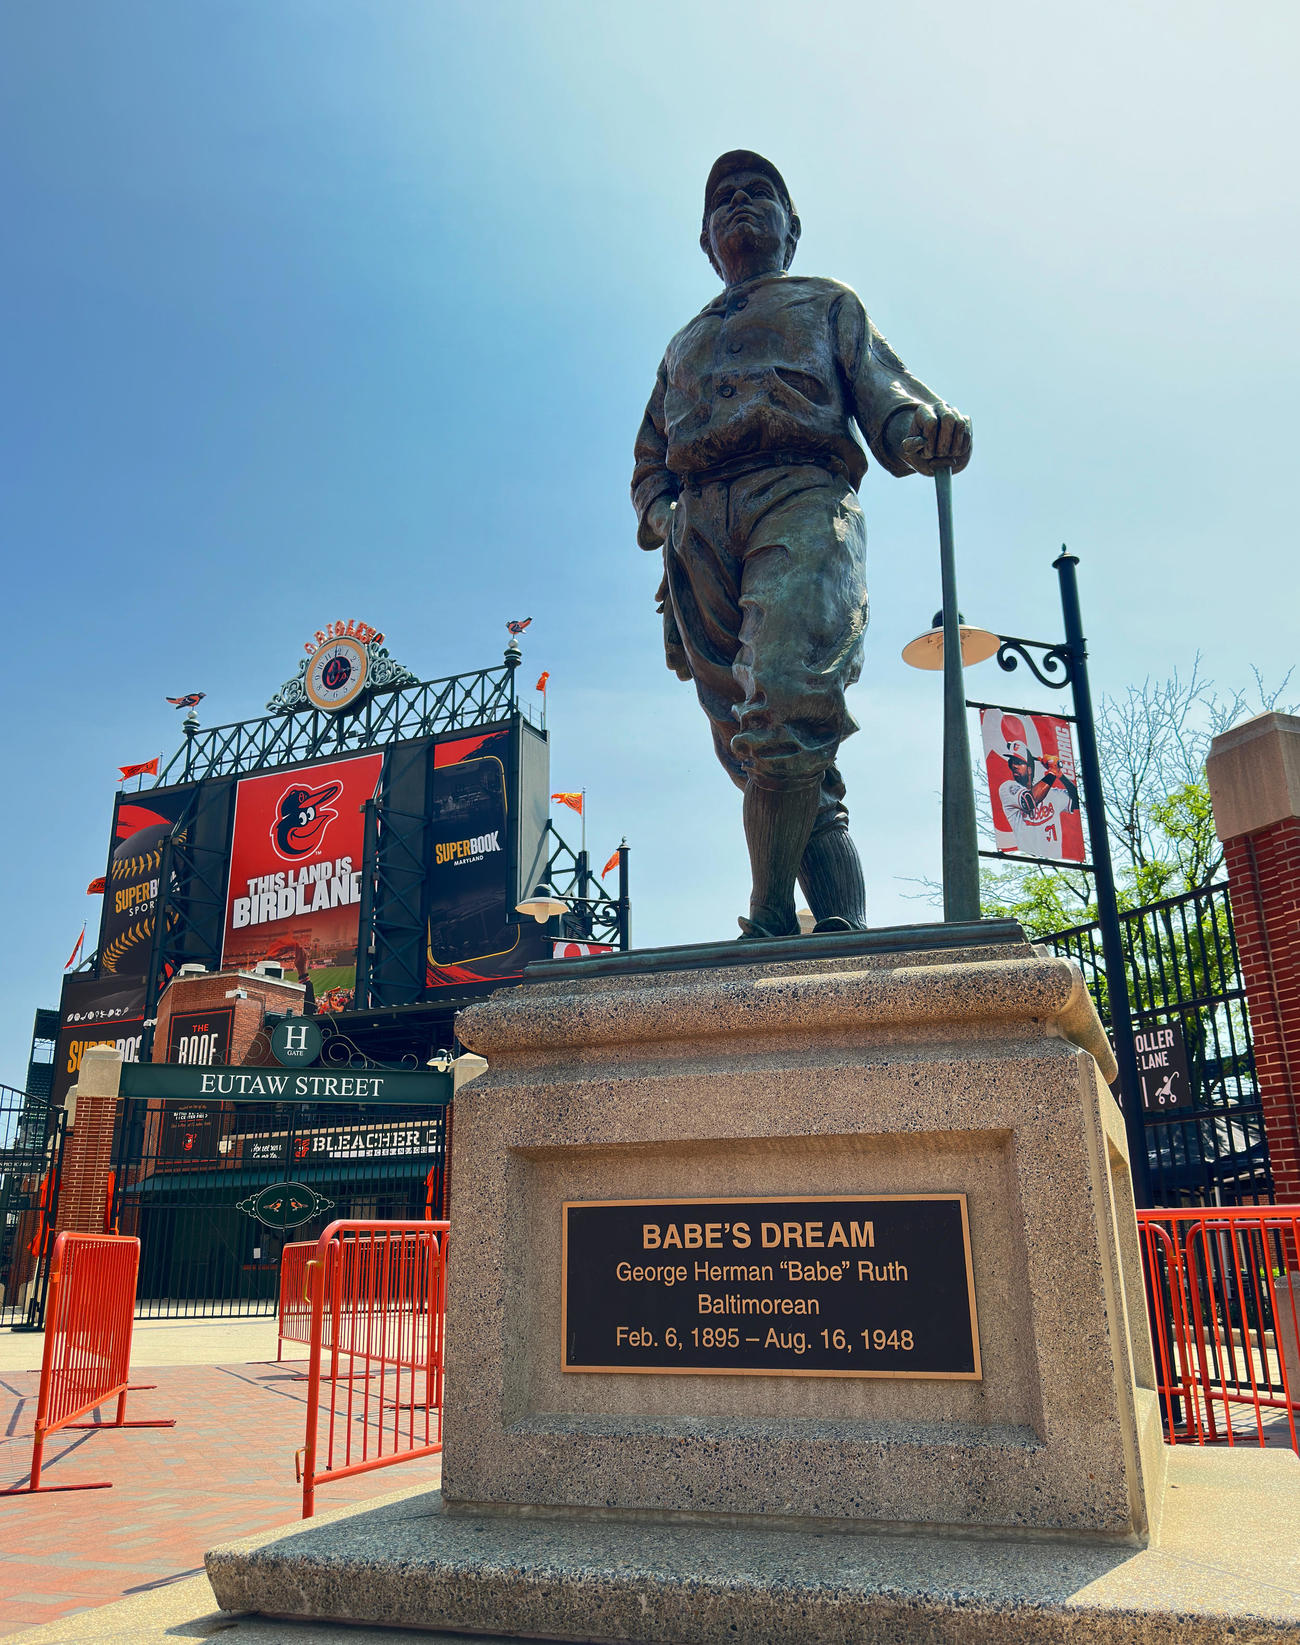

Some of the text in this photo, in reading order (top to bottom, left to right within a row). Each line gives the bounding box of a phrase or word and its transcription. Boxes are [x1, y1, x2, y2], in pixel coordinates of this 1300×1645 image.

[1055, 726, 1075, 780] CEDRIC
[435, 830, 500, 864] SUPERBOOK
[454, 855, 484, 866] MARYLAND
[247, 856, 352, 897] THIS LAND IS
[192, 1024, 209, 1032] THE
[284, 1025, 309, 1050] H
[179, 1034, 218, 1065] ROOF
[1141, 1051, 1169, 1070] LANE
[200, 1074, 384, 1097] EUTAW STREET
[313, 1131, 420, 1151] BLEACHER
[643, 1221, 875, 1248] BABE’S DREAM
[616, 1261, 908, 1287] George Herman “Babe” Ruth
[698, 1294, 820, 1314] Baltimorean
[616, 1327, 658, 1347] Feb.
[665, 1328, 683, 1350] 6,
[691, 1328, 740, 1348] 1895
[764, 1328, 812, 1354] Aug.
[820, 1329, 852, 1353] 16,
[861, 1329, 914, 1350] 1948
